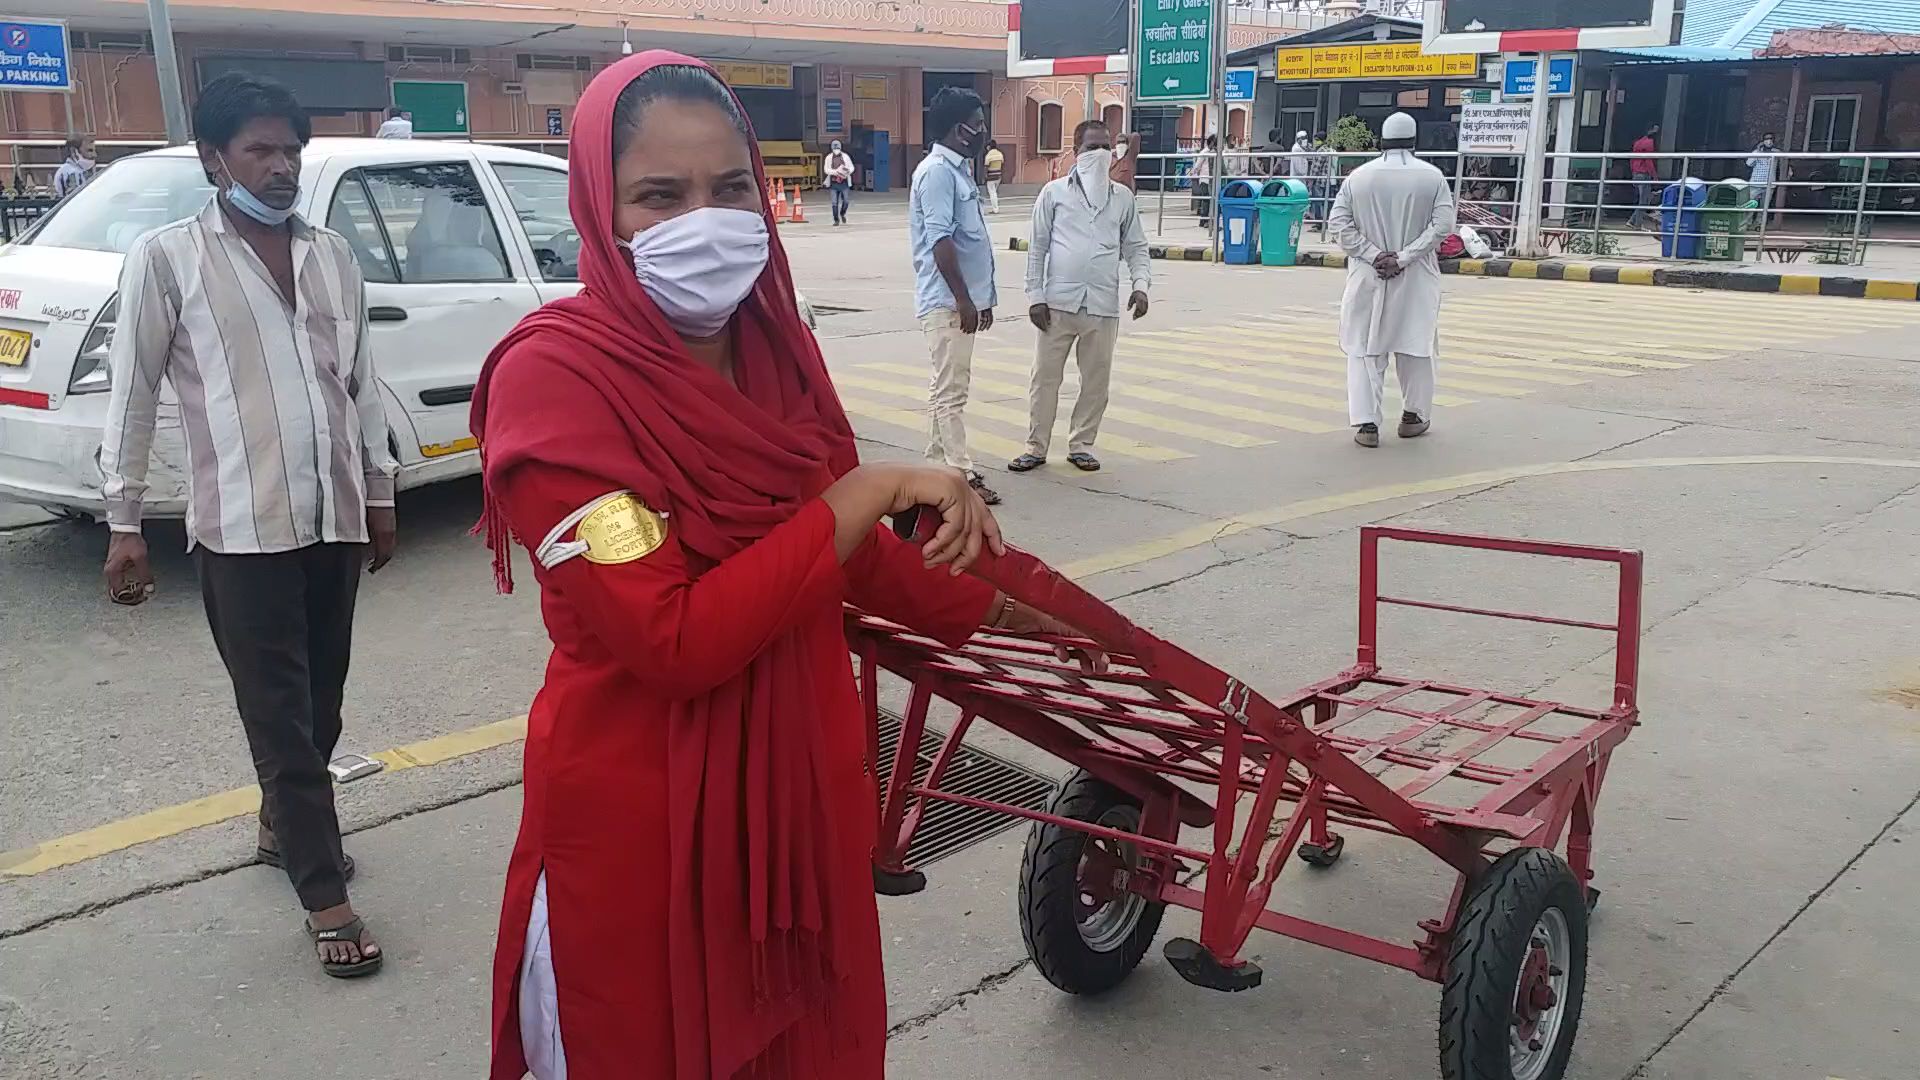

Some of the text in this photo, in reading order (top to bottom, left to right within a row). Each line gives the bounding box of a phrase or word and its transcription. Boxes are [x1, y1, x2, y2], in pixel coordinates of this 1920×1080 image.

[1144, 21, 1177, 41] स्वचालित
[1149, 47, 1200, 65] Escalators
[6, 69, 60, 83] PARKING
[607, 500, 632, 515] RLY
